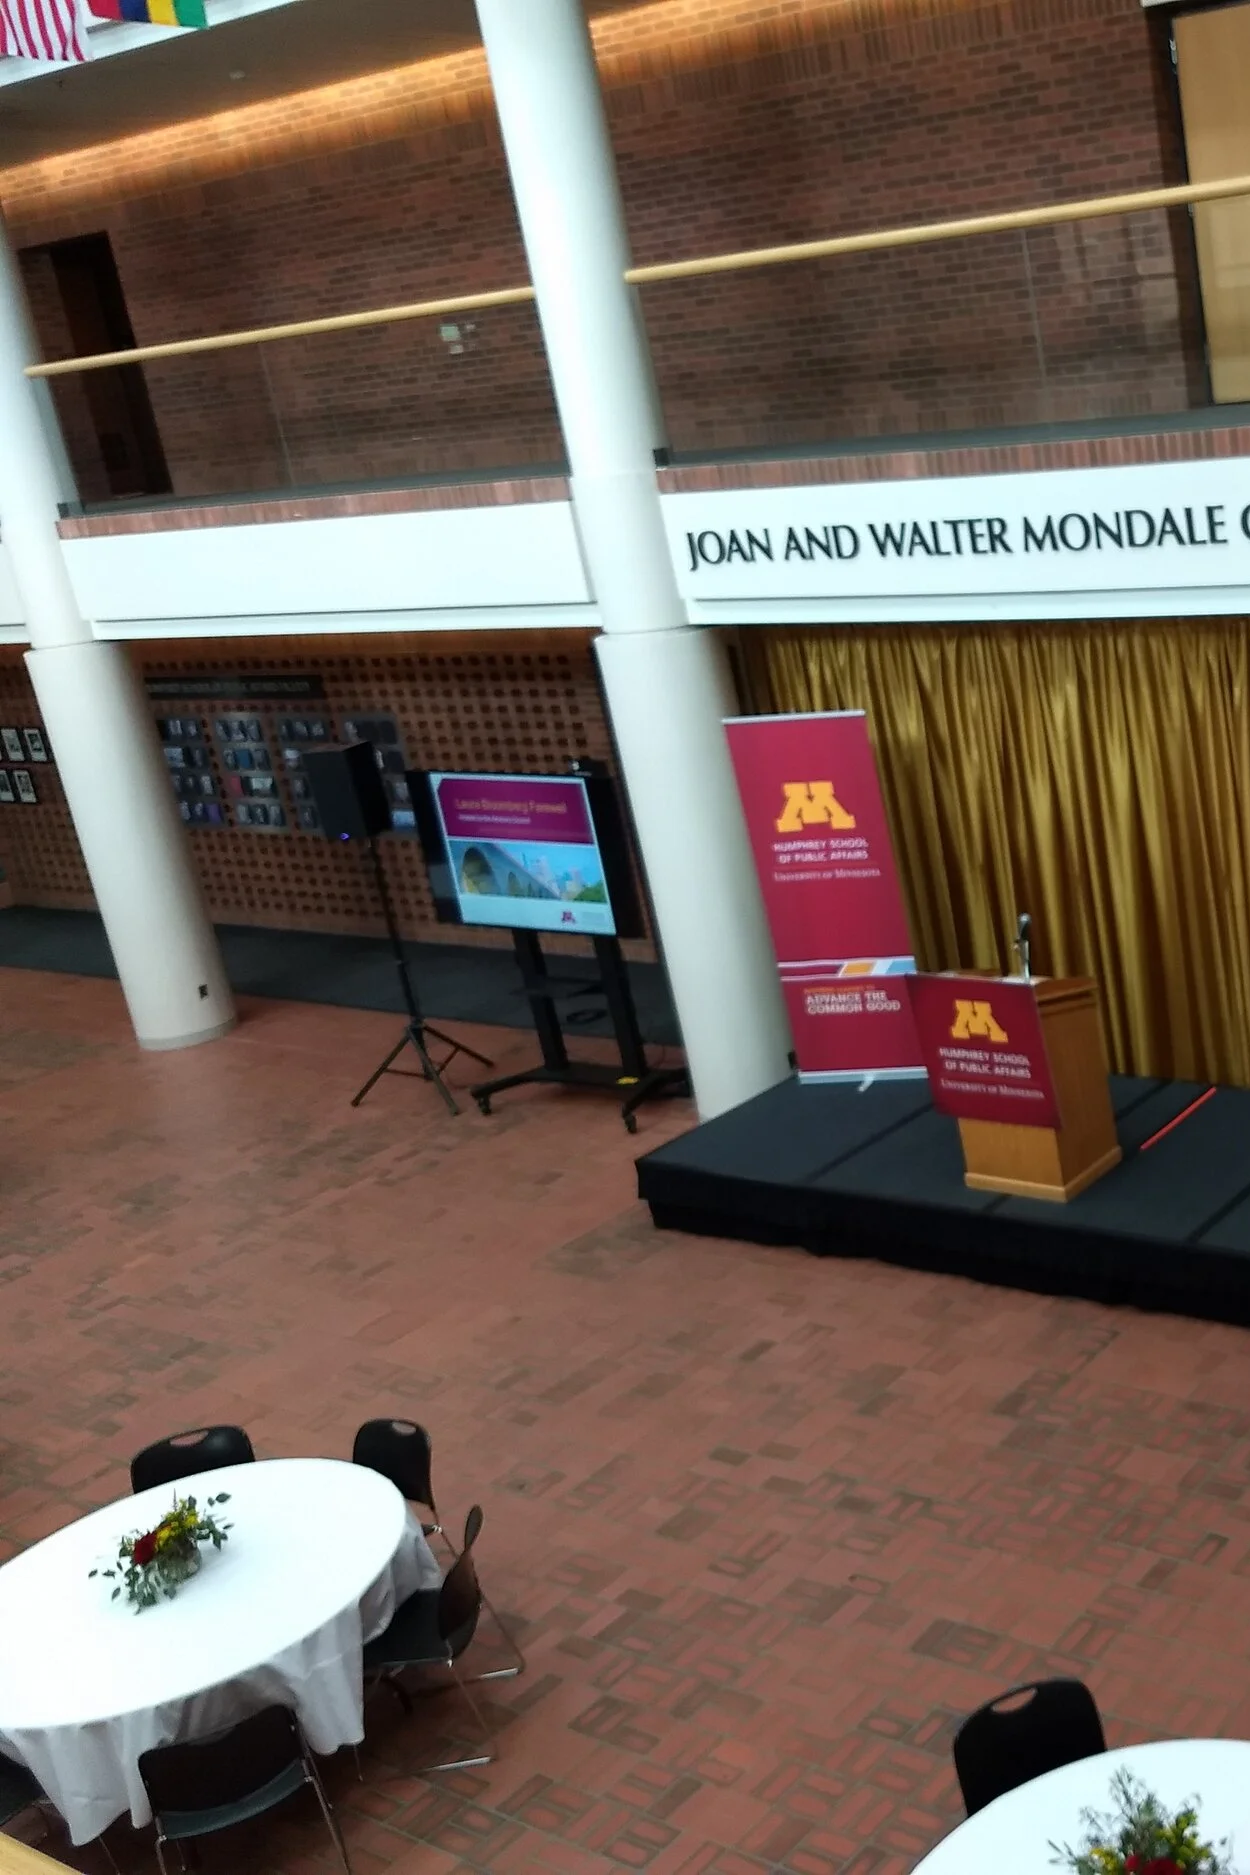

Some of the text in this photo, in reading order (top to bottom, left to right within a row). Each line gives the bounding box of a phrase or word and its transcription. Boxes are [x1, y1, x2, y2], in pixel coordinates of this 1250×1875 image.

[686, 527, 775, 572] JOAN
[784, 523, 861, 561] AND
[867, 516, 1013, 559] WALTER
[1022, 504, 1228, 553] MONDALE
[773, 837, 868, 852] HUMPHREY SCHOOL
[806, 992, 861, 1005] ADVANCE
[864, 989, 887, 1001] THE
[807, 1000, 901, 1015] COMMON GOOD
[939, 1047, 1031, 1067] HUMPHREY SCHOOL
